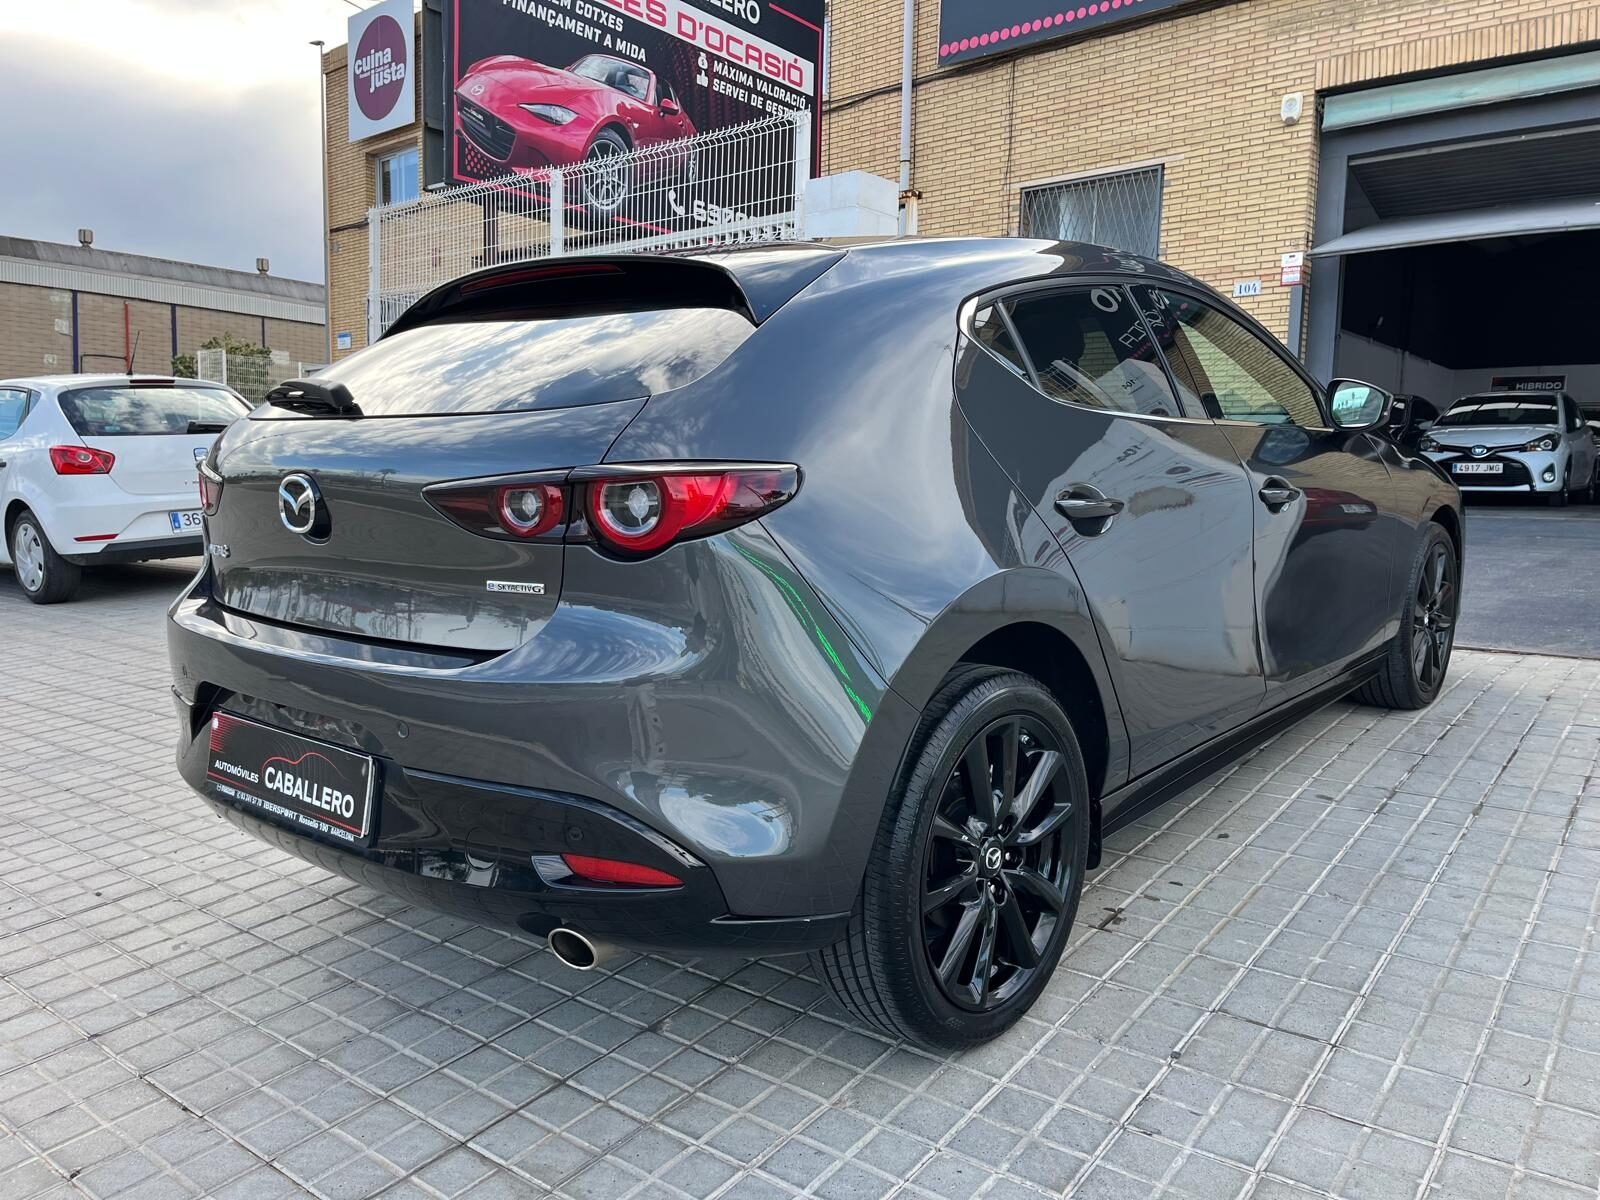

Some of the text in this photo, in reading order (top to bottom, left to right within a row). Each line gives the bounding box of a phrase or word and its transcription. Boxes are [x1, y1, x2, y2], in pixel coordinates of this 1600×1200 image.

[575, 0, 624, 32] COTXES
[354, 47, 392, 75] cuina
[603, 33, 612, 48] A
[616, 38, 647, 62] MIDA
[369, 62, 405, 93] justa
[713, 60, 806, 110] MÀXIMA VALORACIÓ
[712, 78, 749, 103] SERVEI
[750, 93, 764, 109] DE
[1239, 282, 1257, 295] 104
[1515, 382, 1562, 391] HIBRIDO
[1458, 464, 1501, 472] 4917 JMG
[182, 511, 204, 526] 36
[214, 760, 259, 783] AUTOMÓVILES
[264, 766, 355, 818] CABALLERO
